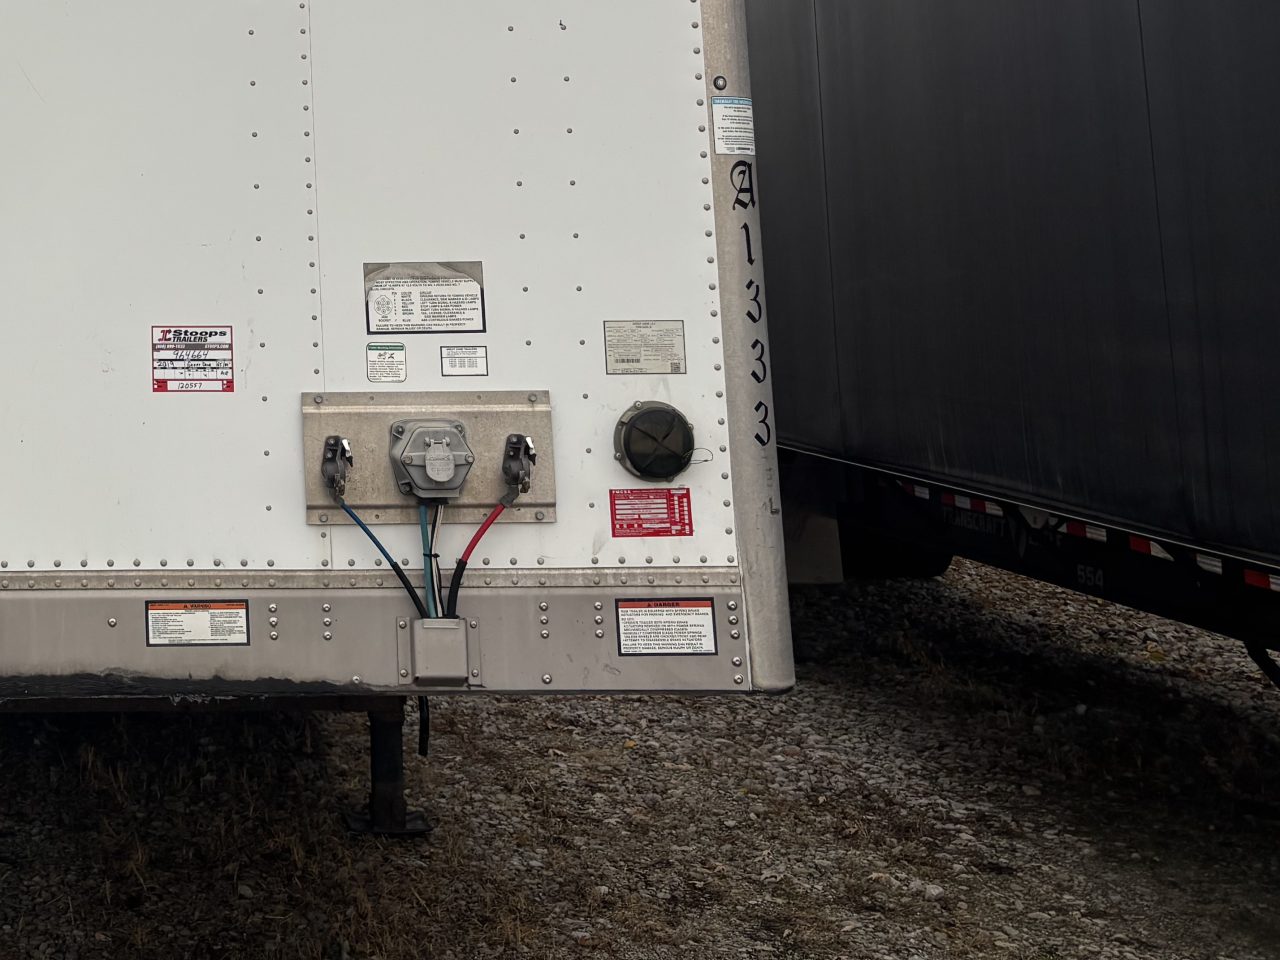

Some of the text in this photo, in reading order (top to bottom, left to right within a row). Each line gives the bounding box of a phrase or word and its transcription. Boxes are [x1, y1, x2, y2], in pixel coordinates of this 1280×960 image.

[730, 160, 771, 447] A1333
[172, 329, 227, 337] Stoops
[1078, 564, 1103, 589] 554
